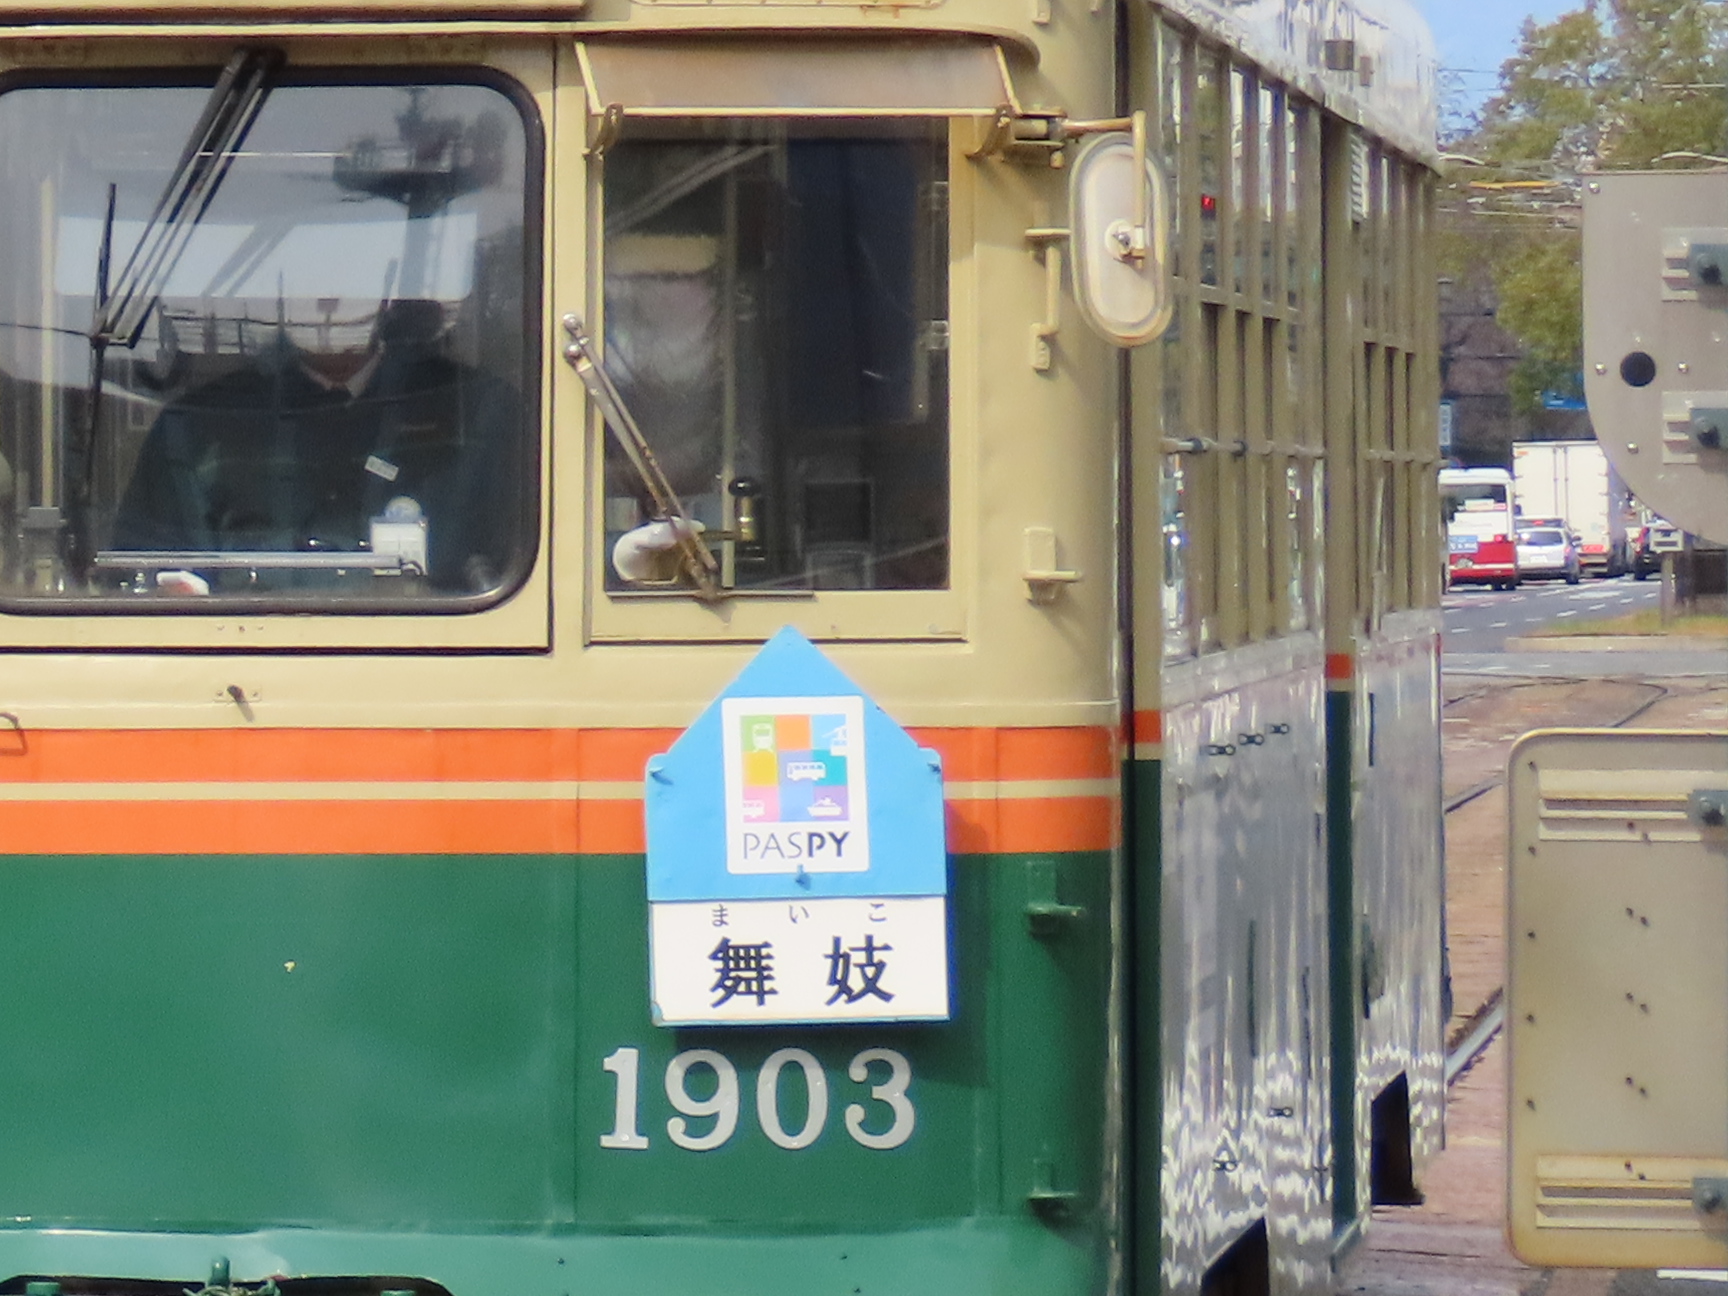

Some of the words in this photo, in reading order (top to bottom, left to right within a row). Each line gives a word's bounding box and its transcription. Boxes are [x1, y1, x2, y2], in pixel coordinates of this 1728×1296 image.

[742, 829, 852, 860] PASPY
[710, 902, 888, 928] まいこ
[707, 934, 899, 1008] 舞妓
[599, 1046, 918, 1153] 1903
